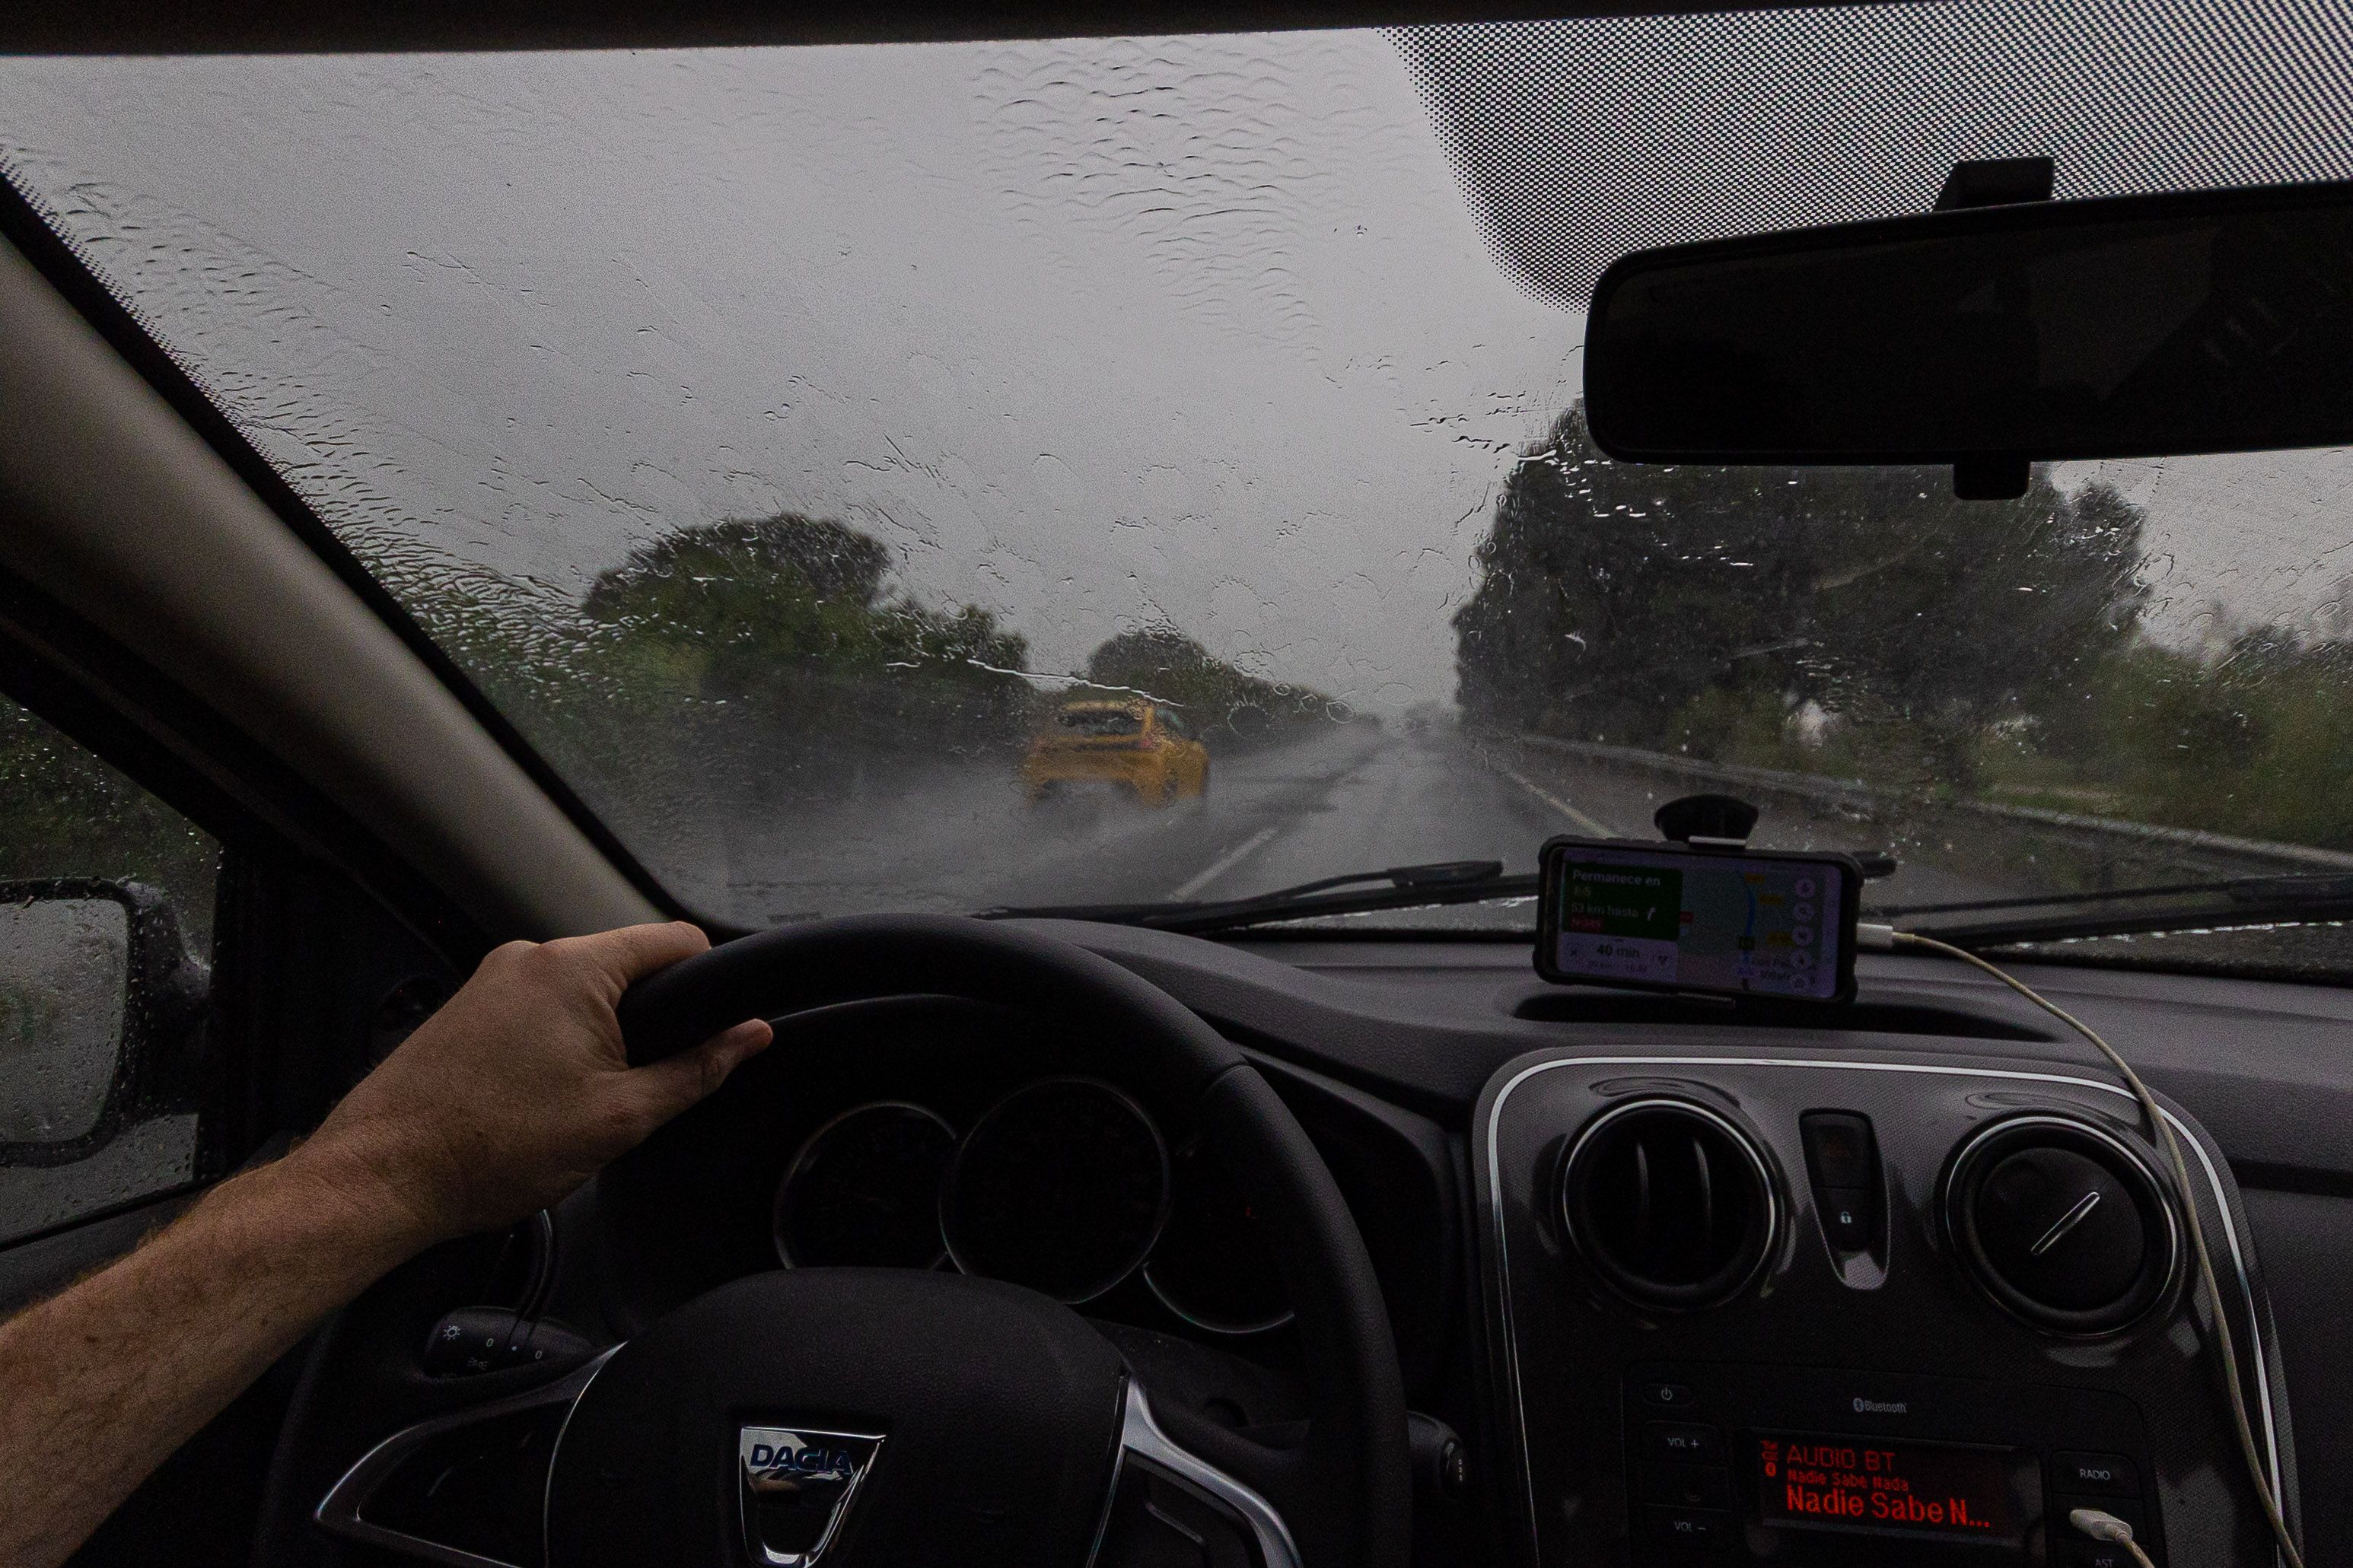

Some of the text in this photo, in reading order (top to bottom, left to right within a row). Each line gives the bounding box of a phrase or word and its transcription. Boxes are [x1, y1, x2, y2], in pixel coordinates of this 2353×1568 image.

[1572, 870, 1661, 886] Permanece en
[1587, 903, 1605, 914] km
[1607, 905, 1639, 918] hasta
[1597, 944, 1640, 958] 40 min
[1865, 1401, 1907, 1413] Bluetooth
[1667, 1437, 1686, 1448] VOL
[749, 1444, 854, 1475] DACIA
[1864, 1450, 1896, 1471] BT
[1787, 1468, 1909, 1492] Nadie Sabe Nada
[2079, 1469, 2110, 1481] RADIO
[1786, 1484, 1865, 1517] Nadie
[1871, 1492, 1944, 1524] Sabe
[1673, 1521, 1693, 1532] VOL
